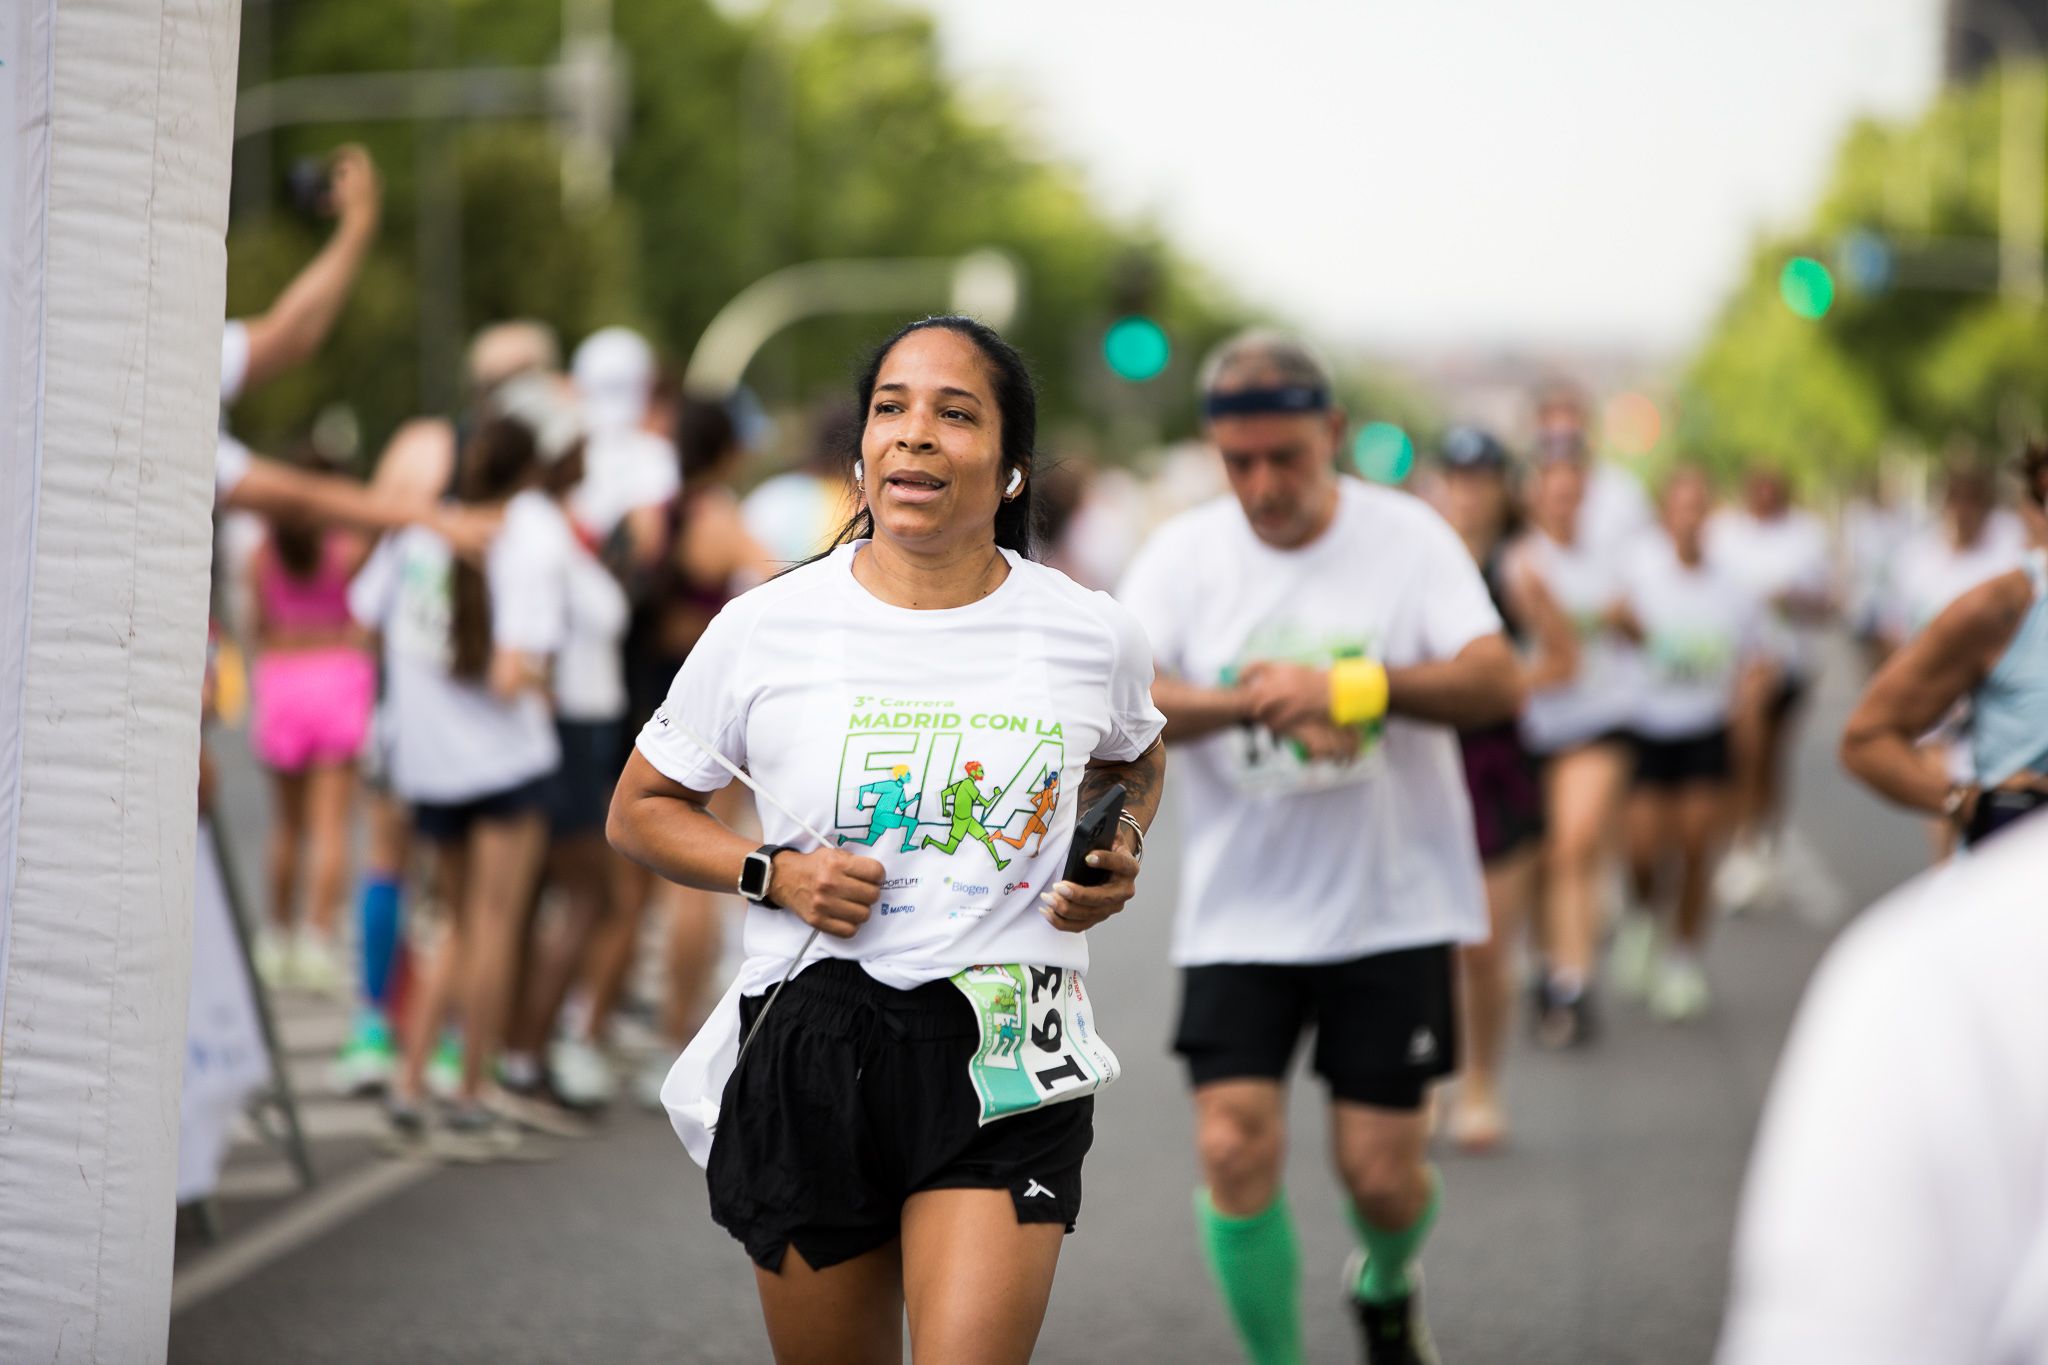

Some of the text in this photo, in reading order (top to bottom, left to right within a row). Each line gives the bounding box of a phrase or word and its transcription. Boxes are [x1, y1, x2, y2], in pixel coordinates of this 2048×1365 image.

[880, 697, 955, 708] Carrera
[848, 712, 1064, 739] MADRID CON LA
[835, 732, 1064, 829] ELA
[952, 882, 989, 896] Biogen
[890, 904, 916, 914] MADRID
[1029, 965, 1088, 1091] 163
